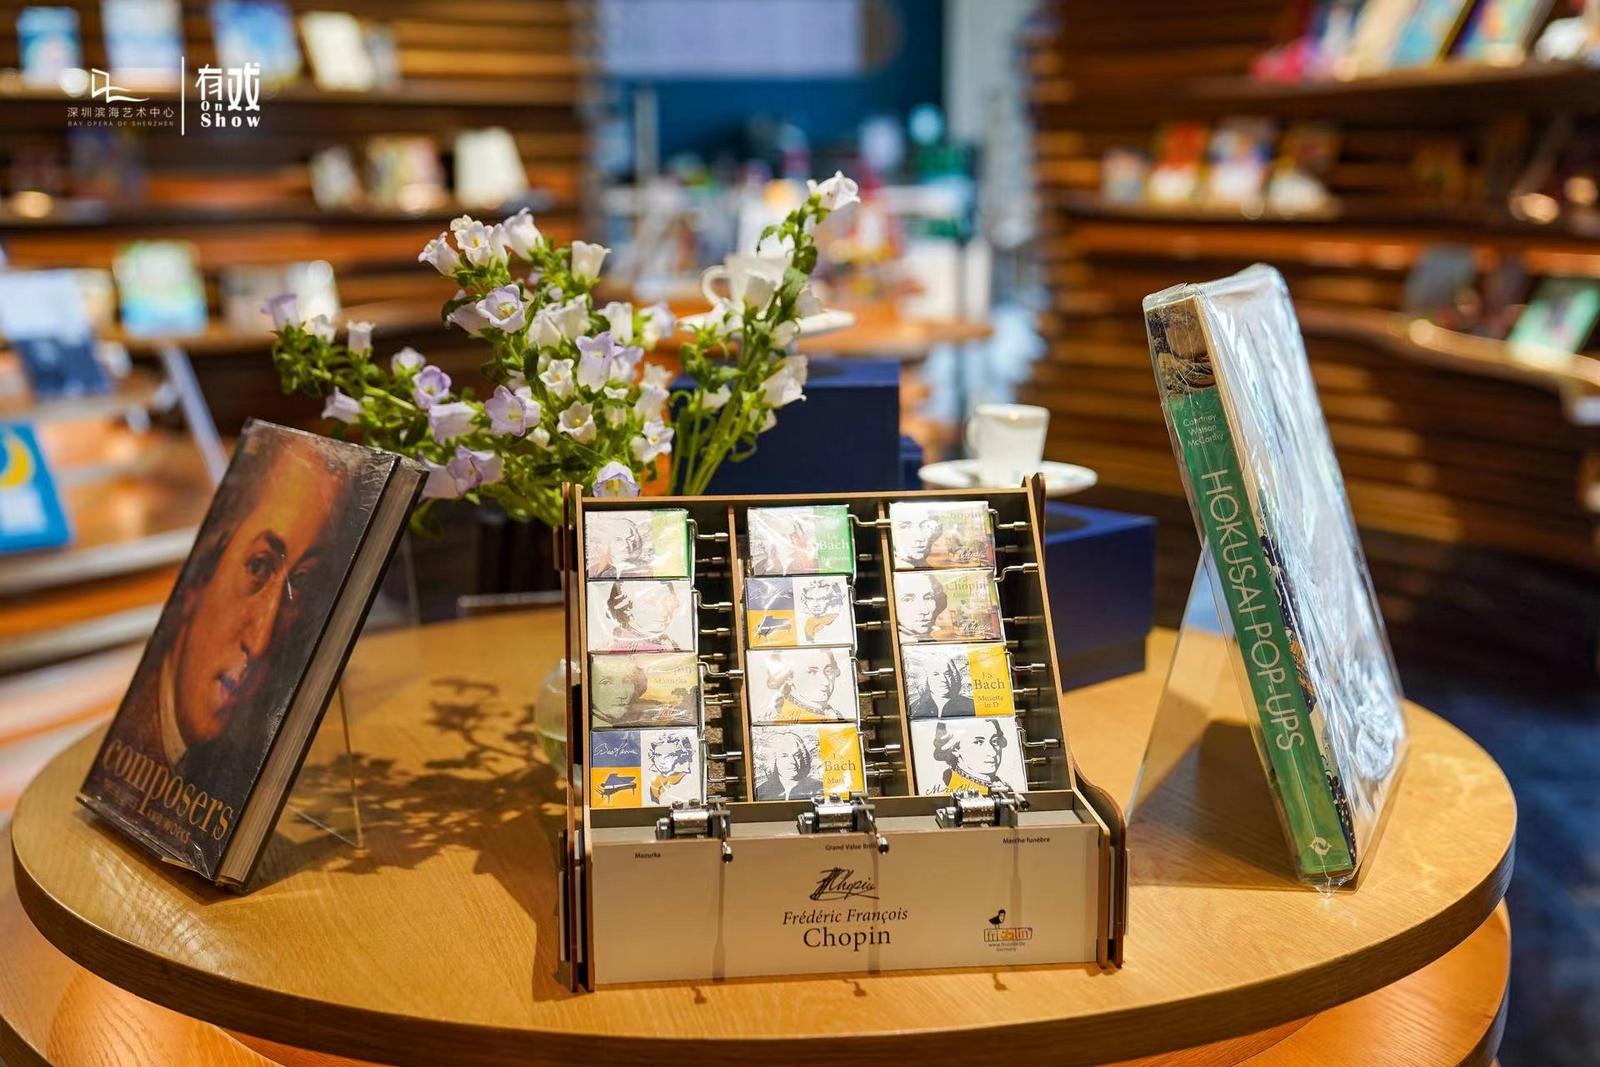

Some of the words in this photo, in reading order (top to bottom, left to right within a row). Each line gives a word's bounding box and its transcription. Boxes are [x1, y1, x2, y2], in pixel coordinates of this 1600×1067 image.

[1183, 415, 1217, 427] Courtney
[1187, 433, 1224, 448] McCarthy
[1201, 469, 1267, 614] HOKUSAI
[974, 678, 1005, 690] Bach
[1244, 622, 1305, 751] POP-UPS
[824, 760, 856, 771] Bach
[103, 739, 235, 841] composers
[782, 909, 842, 925] Frédéric
[845, 907, 909, 924] François
[803, 926, 891, 952] Chopin
